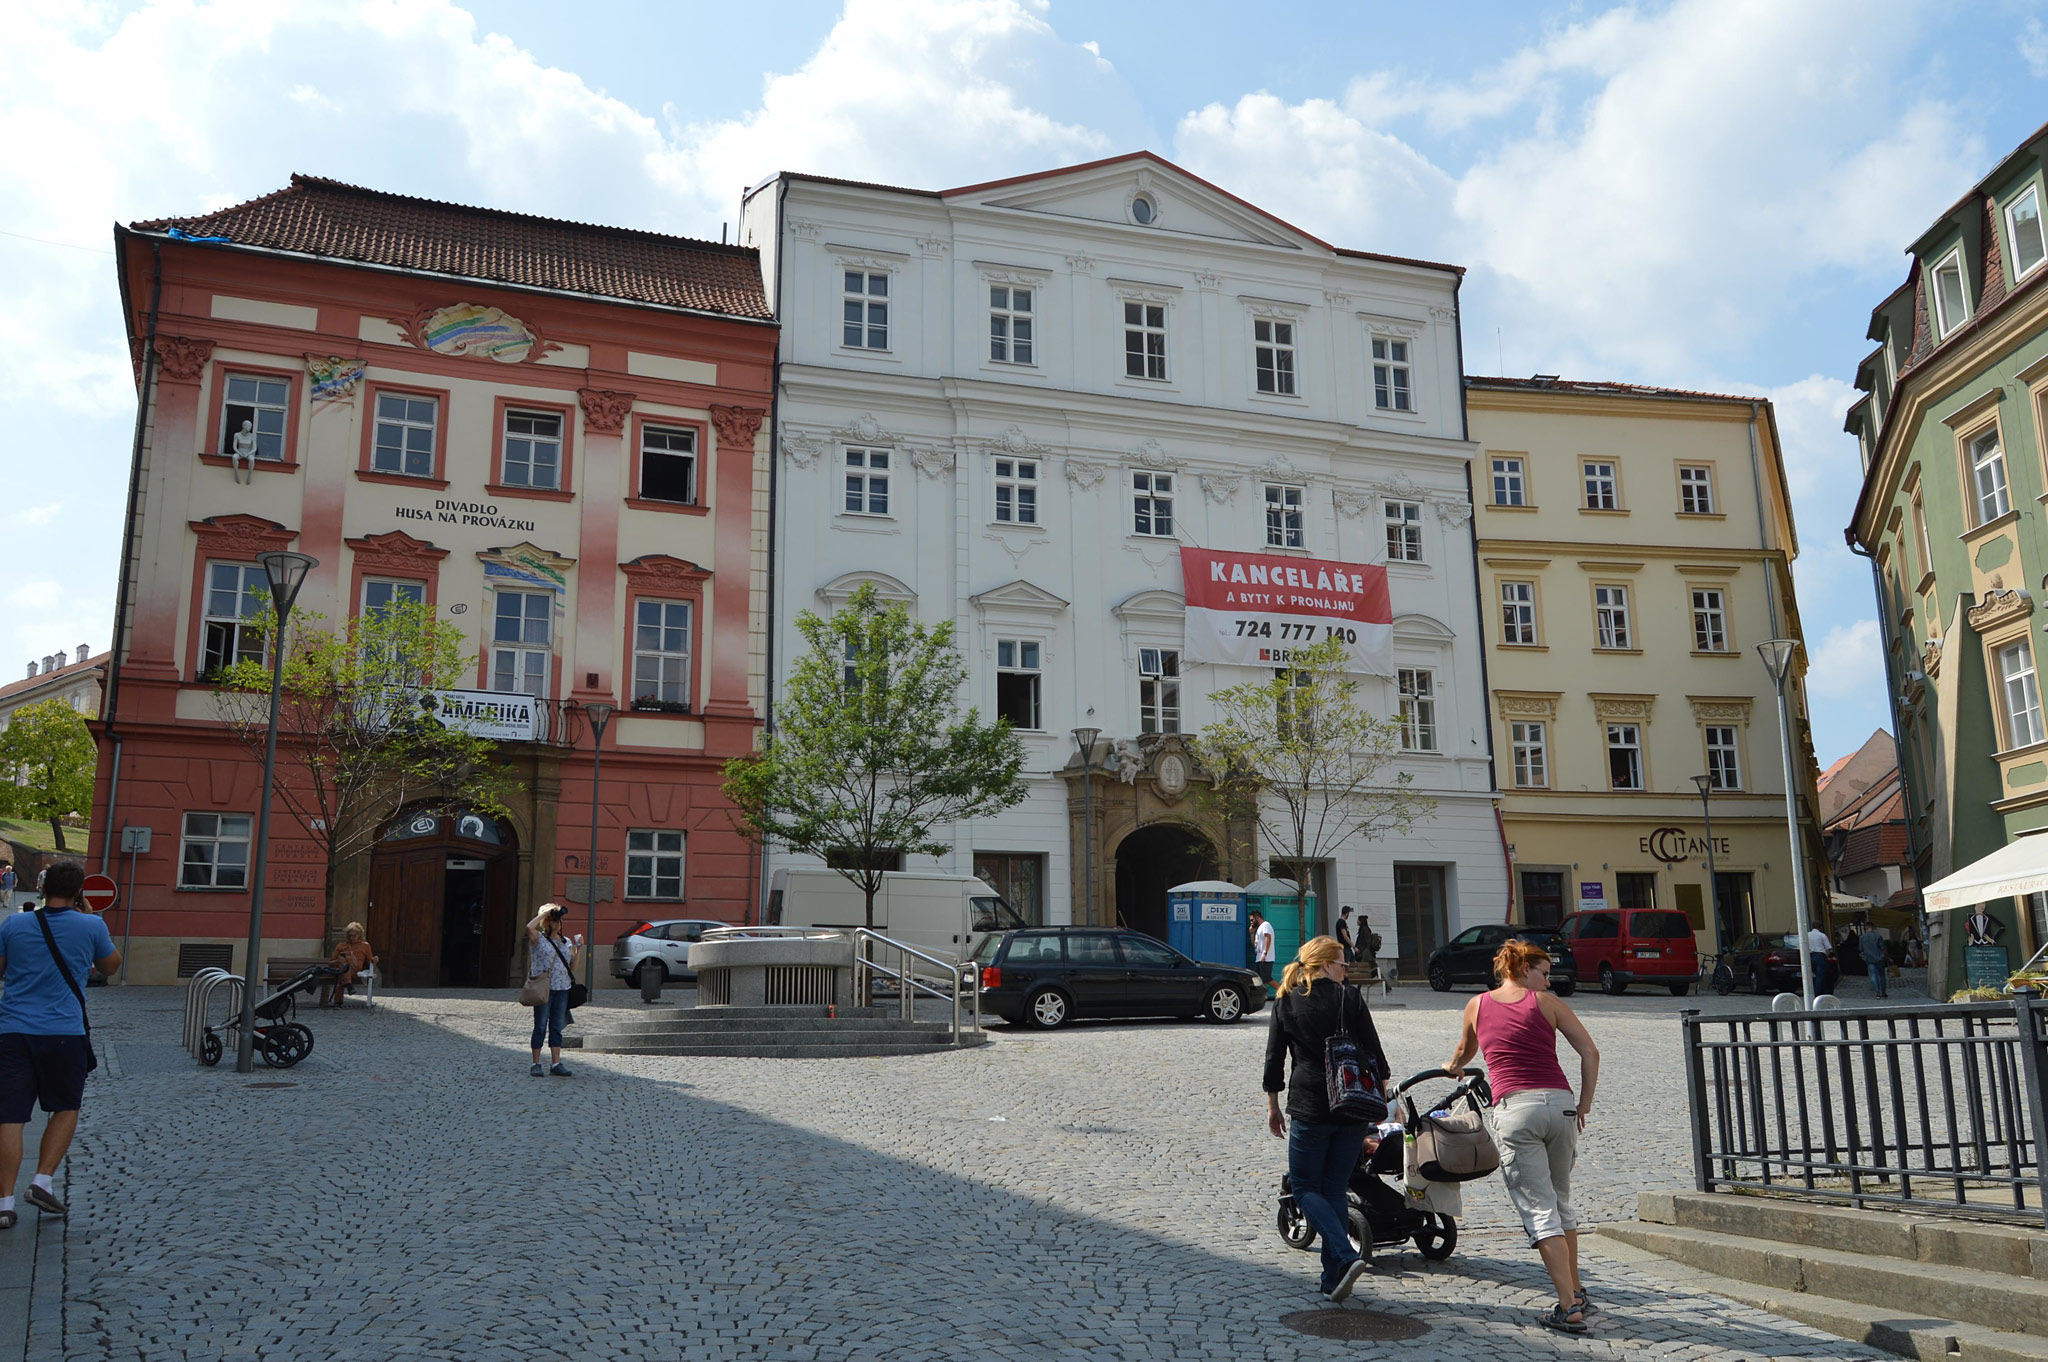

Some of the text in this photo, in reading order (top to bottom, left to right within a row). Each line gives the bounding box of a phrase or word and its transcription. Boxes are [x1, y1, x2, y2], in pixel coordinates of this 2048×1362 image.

[435, 499, 498, 515] DIVADLO
[396, 507, 535, 531] HUSA NA PROVÁZKU
[1210, 561, 1364, 594] KANCELÁŘE
[1226, 591, 1355, 612] A BYTY K PRONÁJMU
[1235, 621, 1272, 638] 724
[1280, 623, 1316, 641] 777
[1326, 626, 1357, 645] 140
[441, 700, 530, 723] AMERIKA
